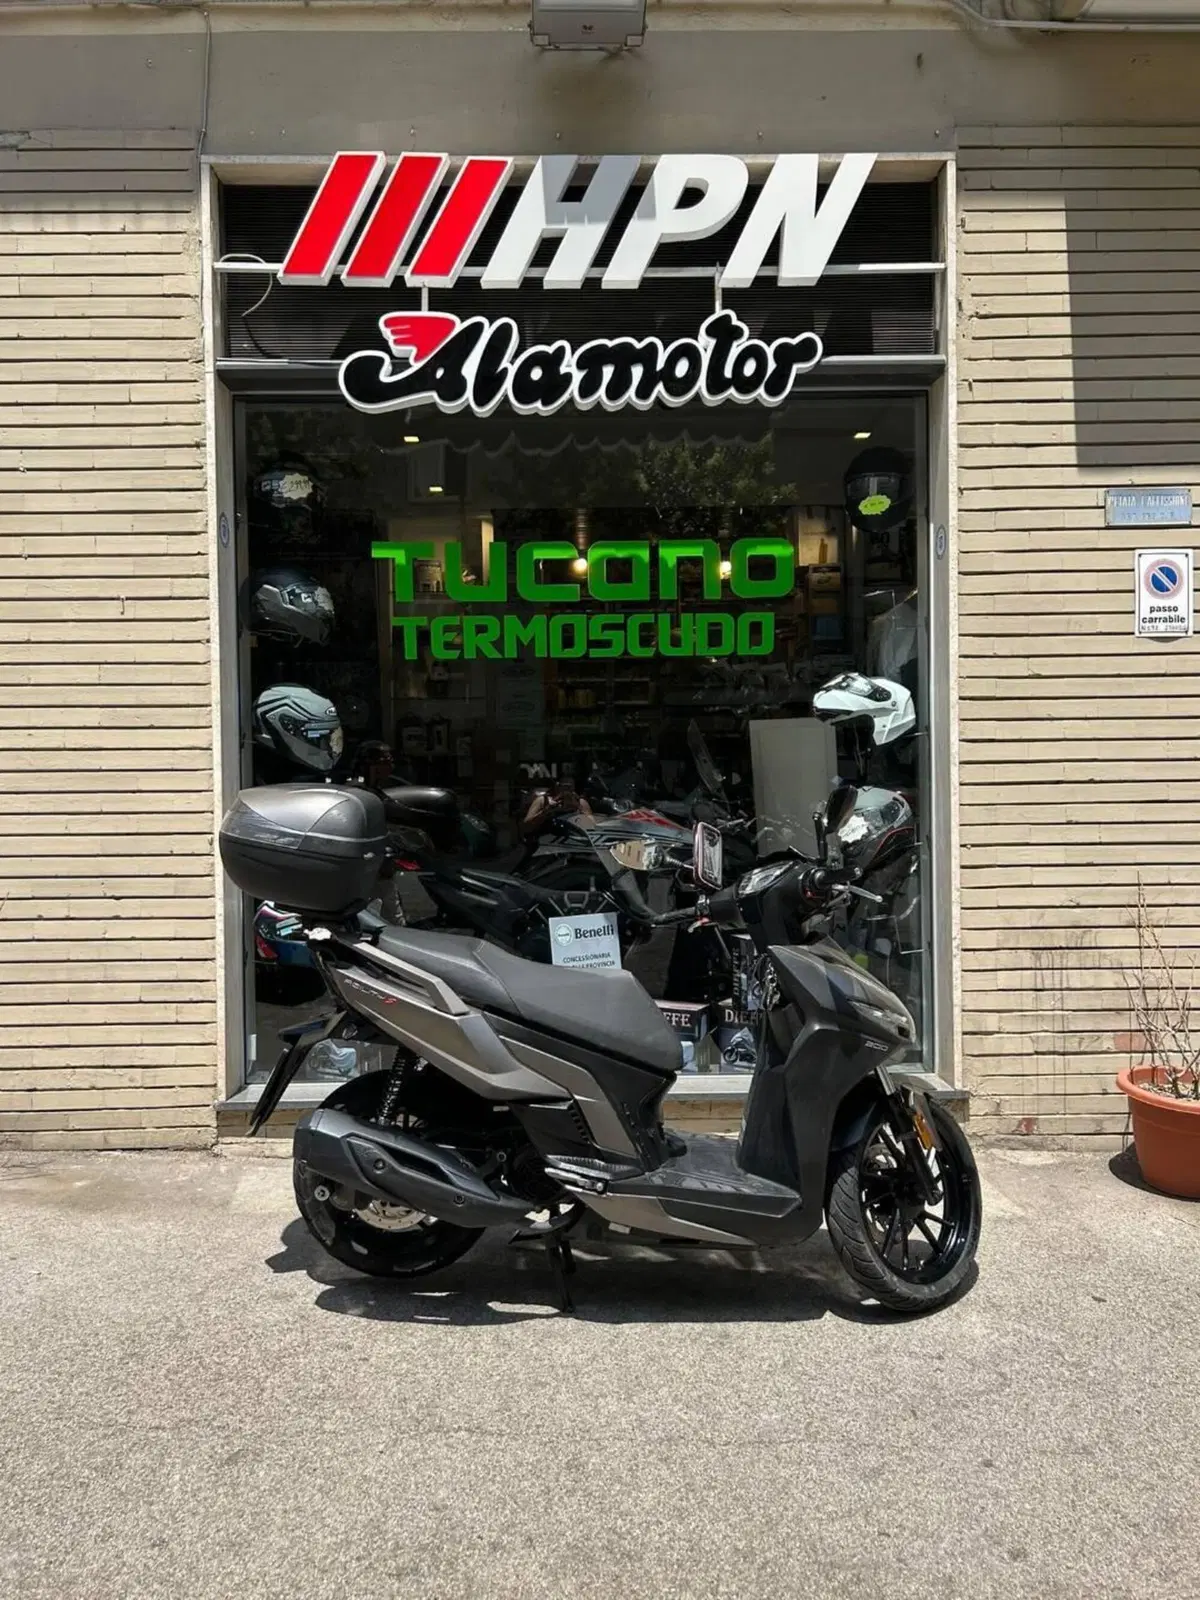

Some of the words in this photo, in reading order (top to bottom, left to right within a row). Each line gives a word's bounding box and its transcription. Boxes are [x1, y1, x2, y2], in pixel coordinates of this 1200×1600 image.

[480, 153, 878, 289] HPN
[338, 309, 823, 417] Alamotor
[371, 538, 795, 603] TUCANO
[1141, 614, 1186, 624] carrabile
[1149, 605, 1179, 614] passo
[391, 612, 775, 661] TERMOSCUDO
[574, 925, 614, 940] Benelli
[663, 1012, 692, 1027] FFE
